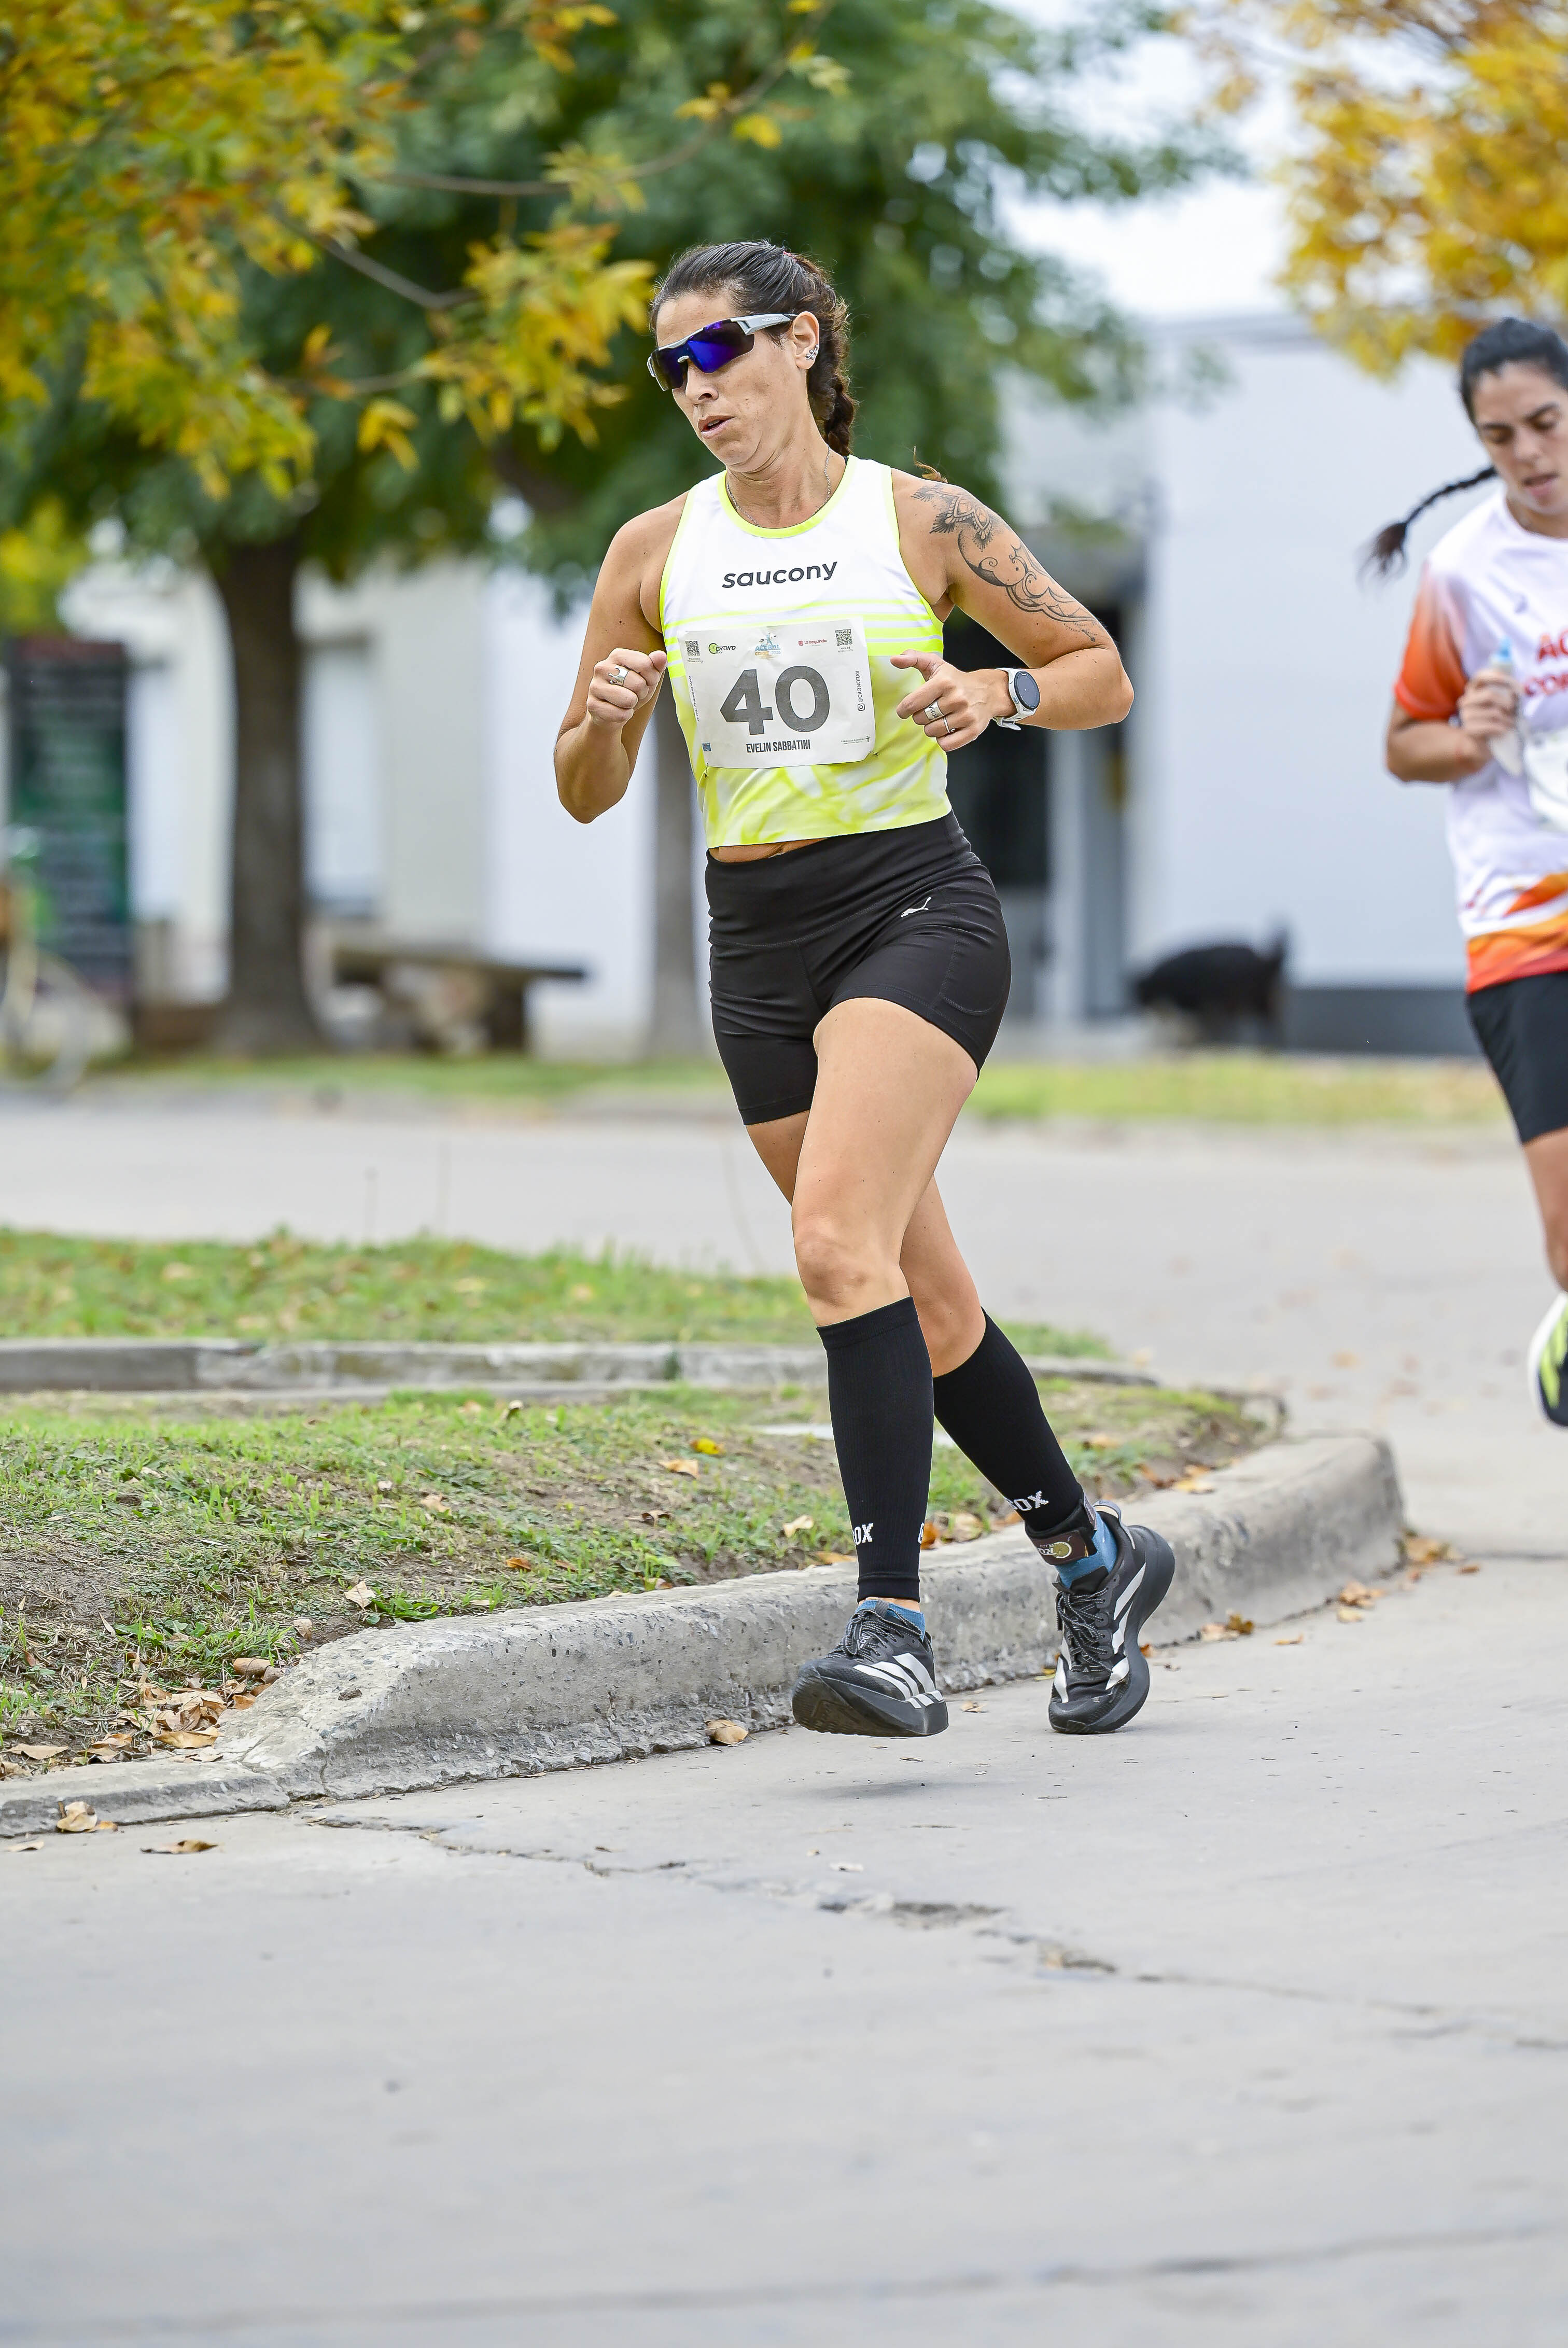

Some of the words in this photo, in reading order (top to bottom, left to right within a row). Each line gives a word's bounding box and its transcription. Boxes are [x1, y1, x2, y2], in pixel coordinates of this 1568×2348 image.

[722, 562, 837, 589] saucony
[855, 670, 863, 702] @CRONORAV
[720, 665, 830, 735] 40
[746, 742, 772, 753] EVELIN
[773, 739, 810, 751] SABBATINI
[852, 1522, 874, 1547] OX
